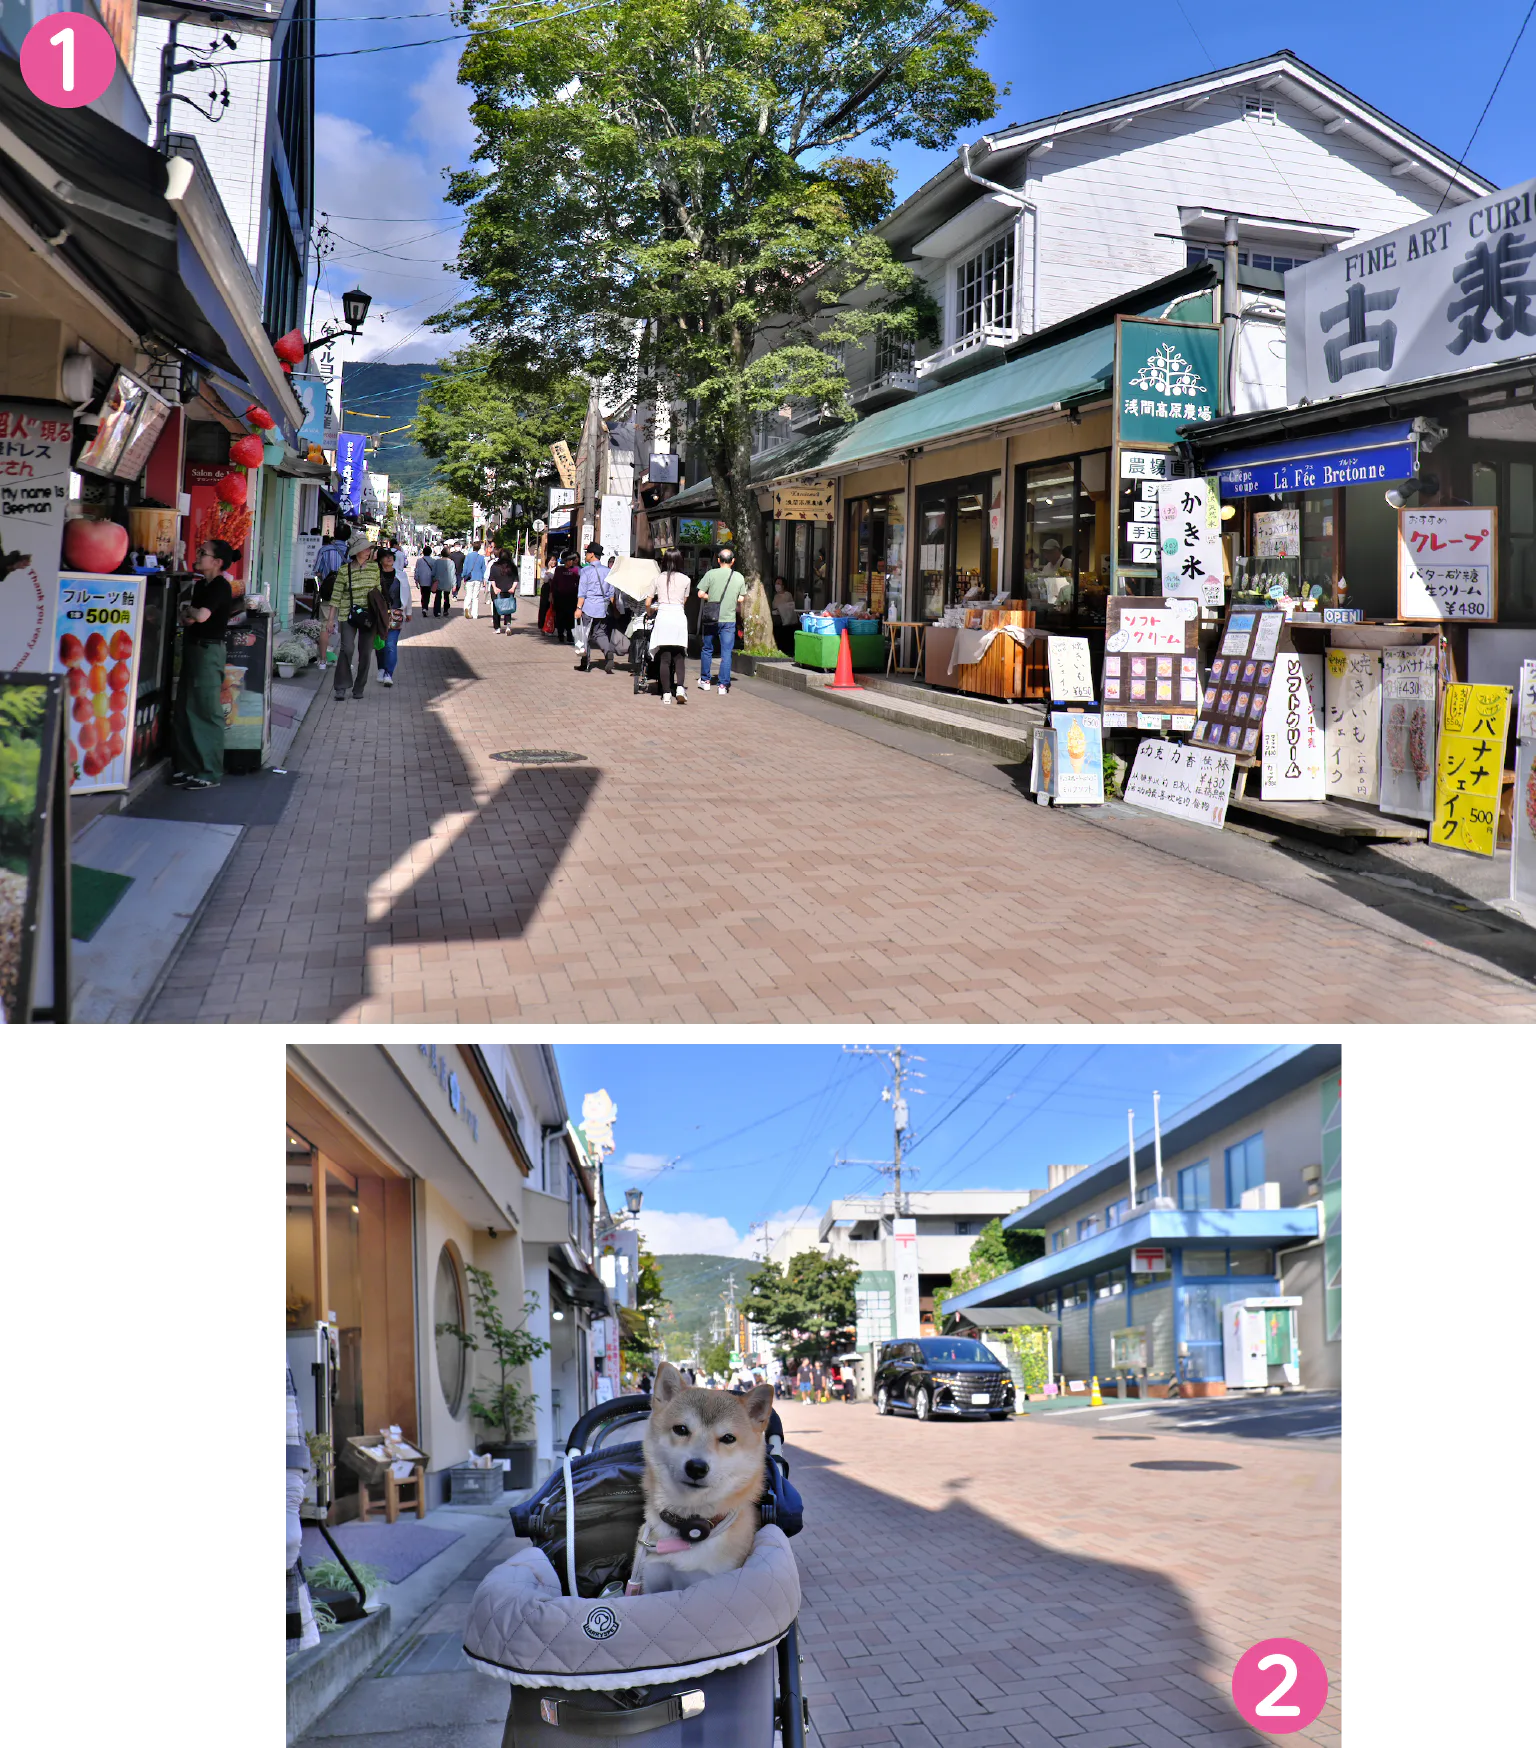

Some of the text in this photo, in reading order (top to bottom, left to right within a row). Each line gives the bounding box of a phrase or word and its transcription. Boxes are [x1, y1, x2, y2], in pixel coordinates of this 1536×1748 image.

[1345, 192, 1536, 282] FINE ART CURI
[1124, 399, 1212, 421] 浅間高原農場
[191, 468, 213, 478] Salon
[1295, 469, 1316, 487] Fée
[1323, 464, 1386, 484] Bretonne
[1234, 481, 1259, 493] soupe
[1409, 515, 1448, 525] おすすめ
[1180, 491, 1206, 580] かき氷
[1410, 529, 1490, 553] クレープ
[1409, 568, 1480, 583] バター砂糖
[63, 590, 135, 606] フルーツ飴
[1425, 585, 1482, 597] 生クリーム
[1325, 610, 1358, 623] OPEN
[1445, 601, 1486, 615] ¥480
[1124, 616, 1162, 627] ソフト
[1133, 631, 1182, 646] クリーム
[1350, 652, 1373, 743] 焼きいも
[1284, 659, 1302, 779] ソフトクリーム
[1331, 706, 1346, 784] シェイク
[1470, 716, 1497, 786] バナナ
[1443, 755, 1467, 841] シェイク
[1469, 807, 1494, 825] 500
